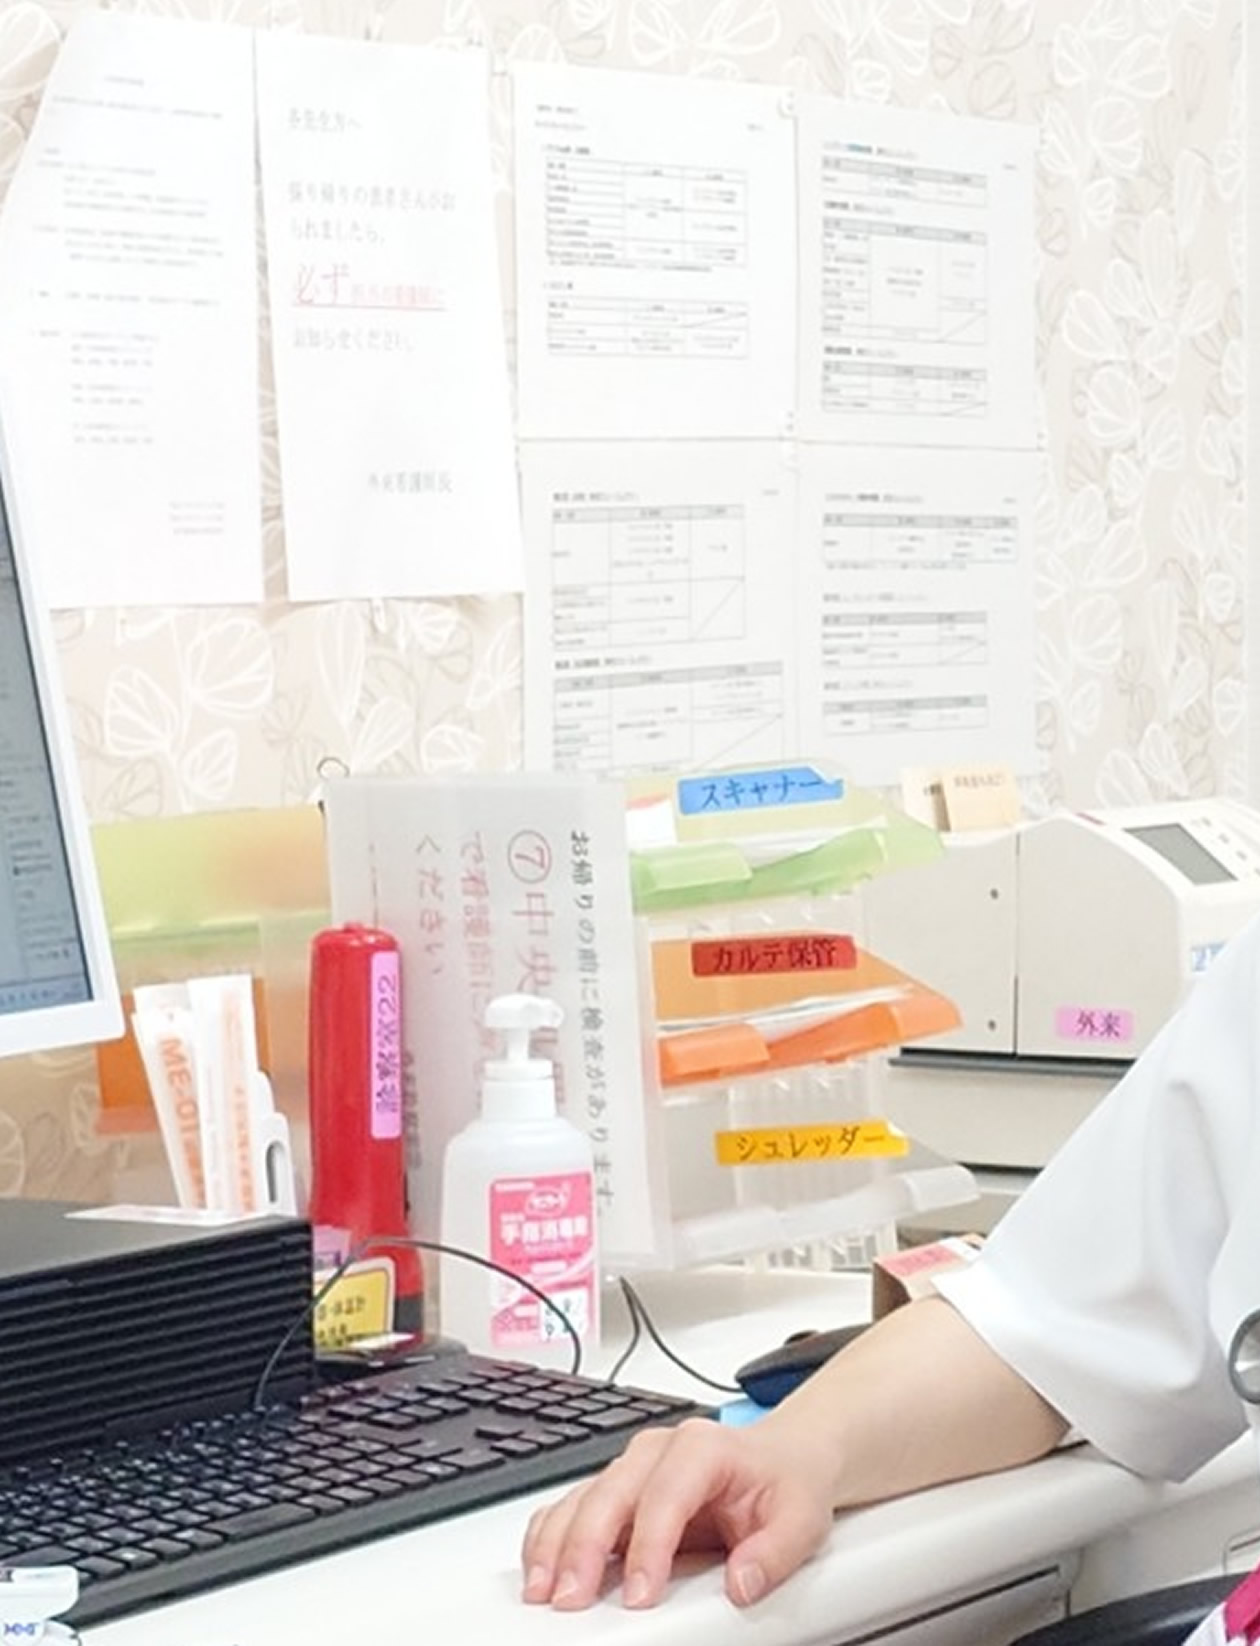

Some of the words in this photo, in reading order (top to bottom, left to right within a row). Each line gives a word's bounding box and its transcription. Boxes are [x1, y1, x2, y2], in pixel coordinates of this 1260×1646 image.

[701, 774, 823, 809] スキャナー
[713, 938, 836, 972] カルテ保管
[1075, 1010, 1120, 1038] 外来
[736, 1125, 886, 1161] シュレッダー
